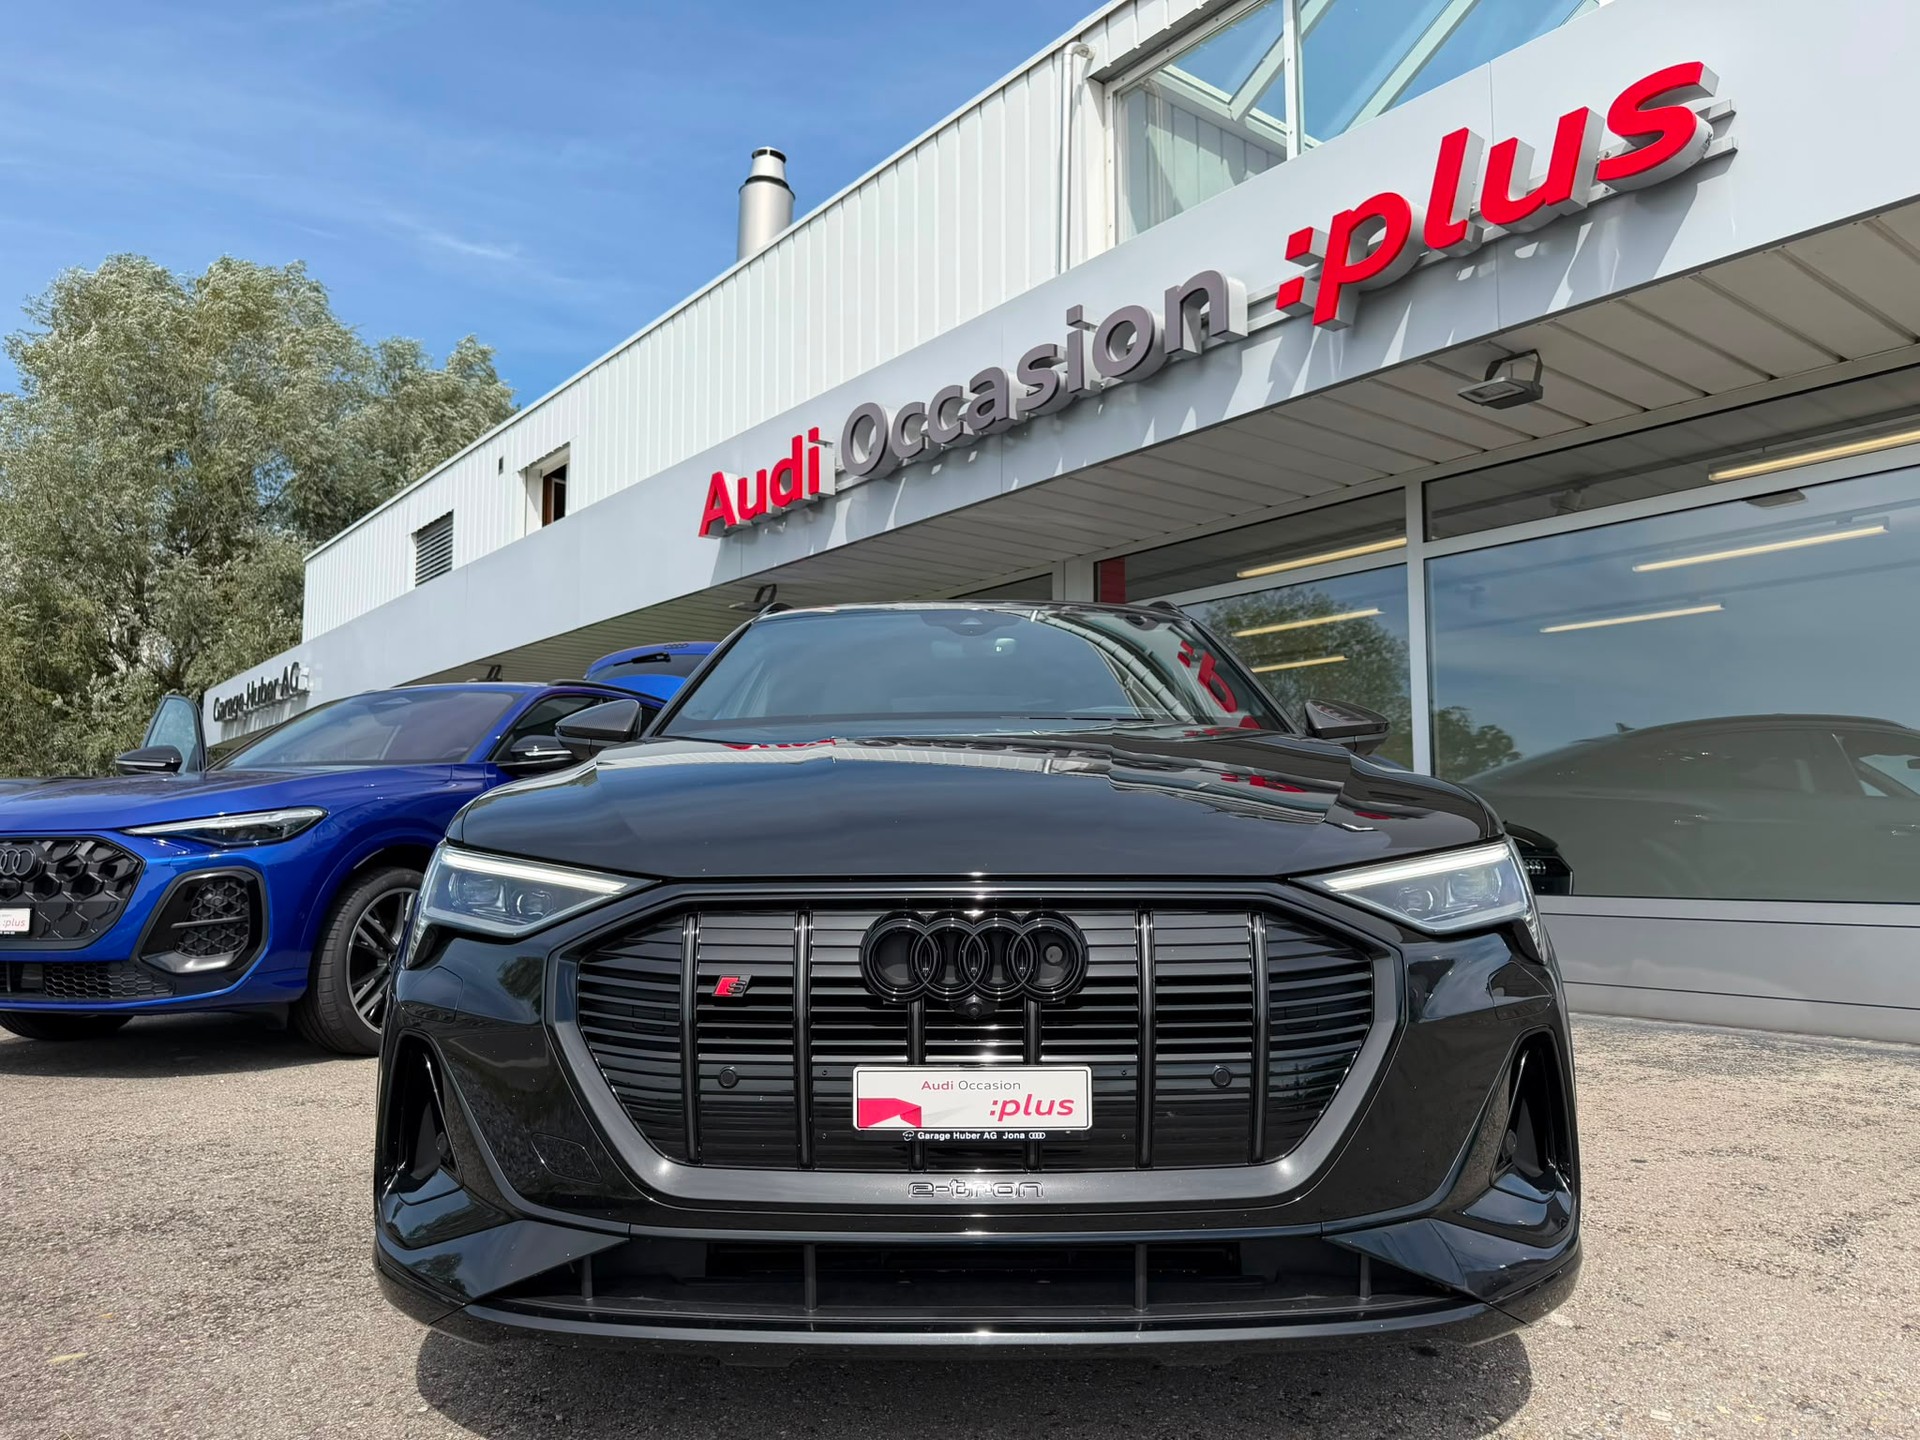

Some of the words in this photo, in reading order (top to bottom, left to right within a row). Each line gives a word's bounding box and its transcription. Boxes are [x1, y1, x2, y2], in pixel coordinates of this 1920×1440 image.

[698, 426, 822, 539] Audi
[840, 268, 1234, 480] Occasion
[1275, 60, 1708, 330] :plus
[213, 693, 246, 722] Garage
[246, 676, 280, 710] Huber
[281, 661, 301, 699] AG
[921, 1080, 954, 1091] Audi
[958, 1079, 1021, 1091] Occasion
[989, 1093, 1075, 1122] :plus
[917, 1131, 950, 1141] Garage
[953, 1131, 981, 1140] Huber
[983, 1131, 998, 1140] AG
[1002, 1131, 1026, 1140] Jona
[907, 1179, 1045, 1198] e-tron
